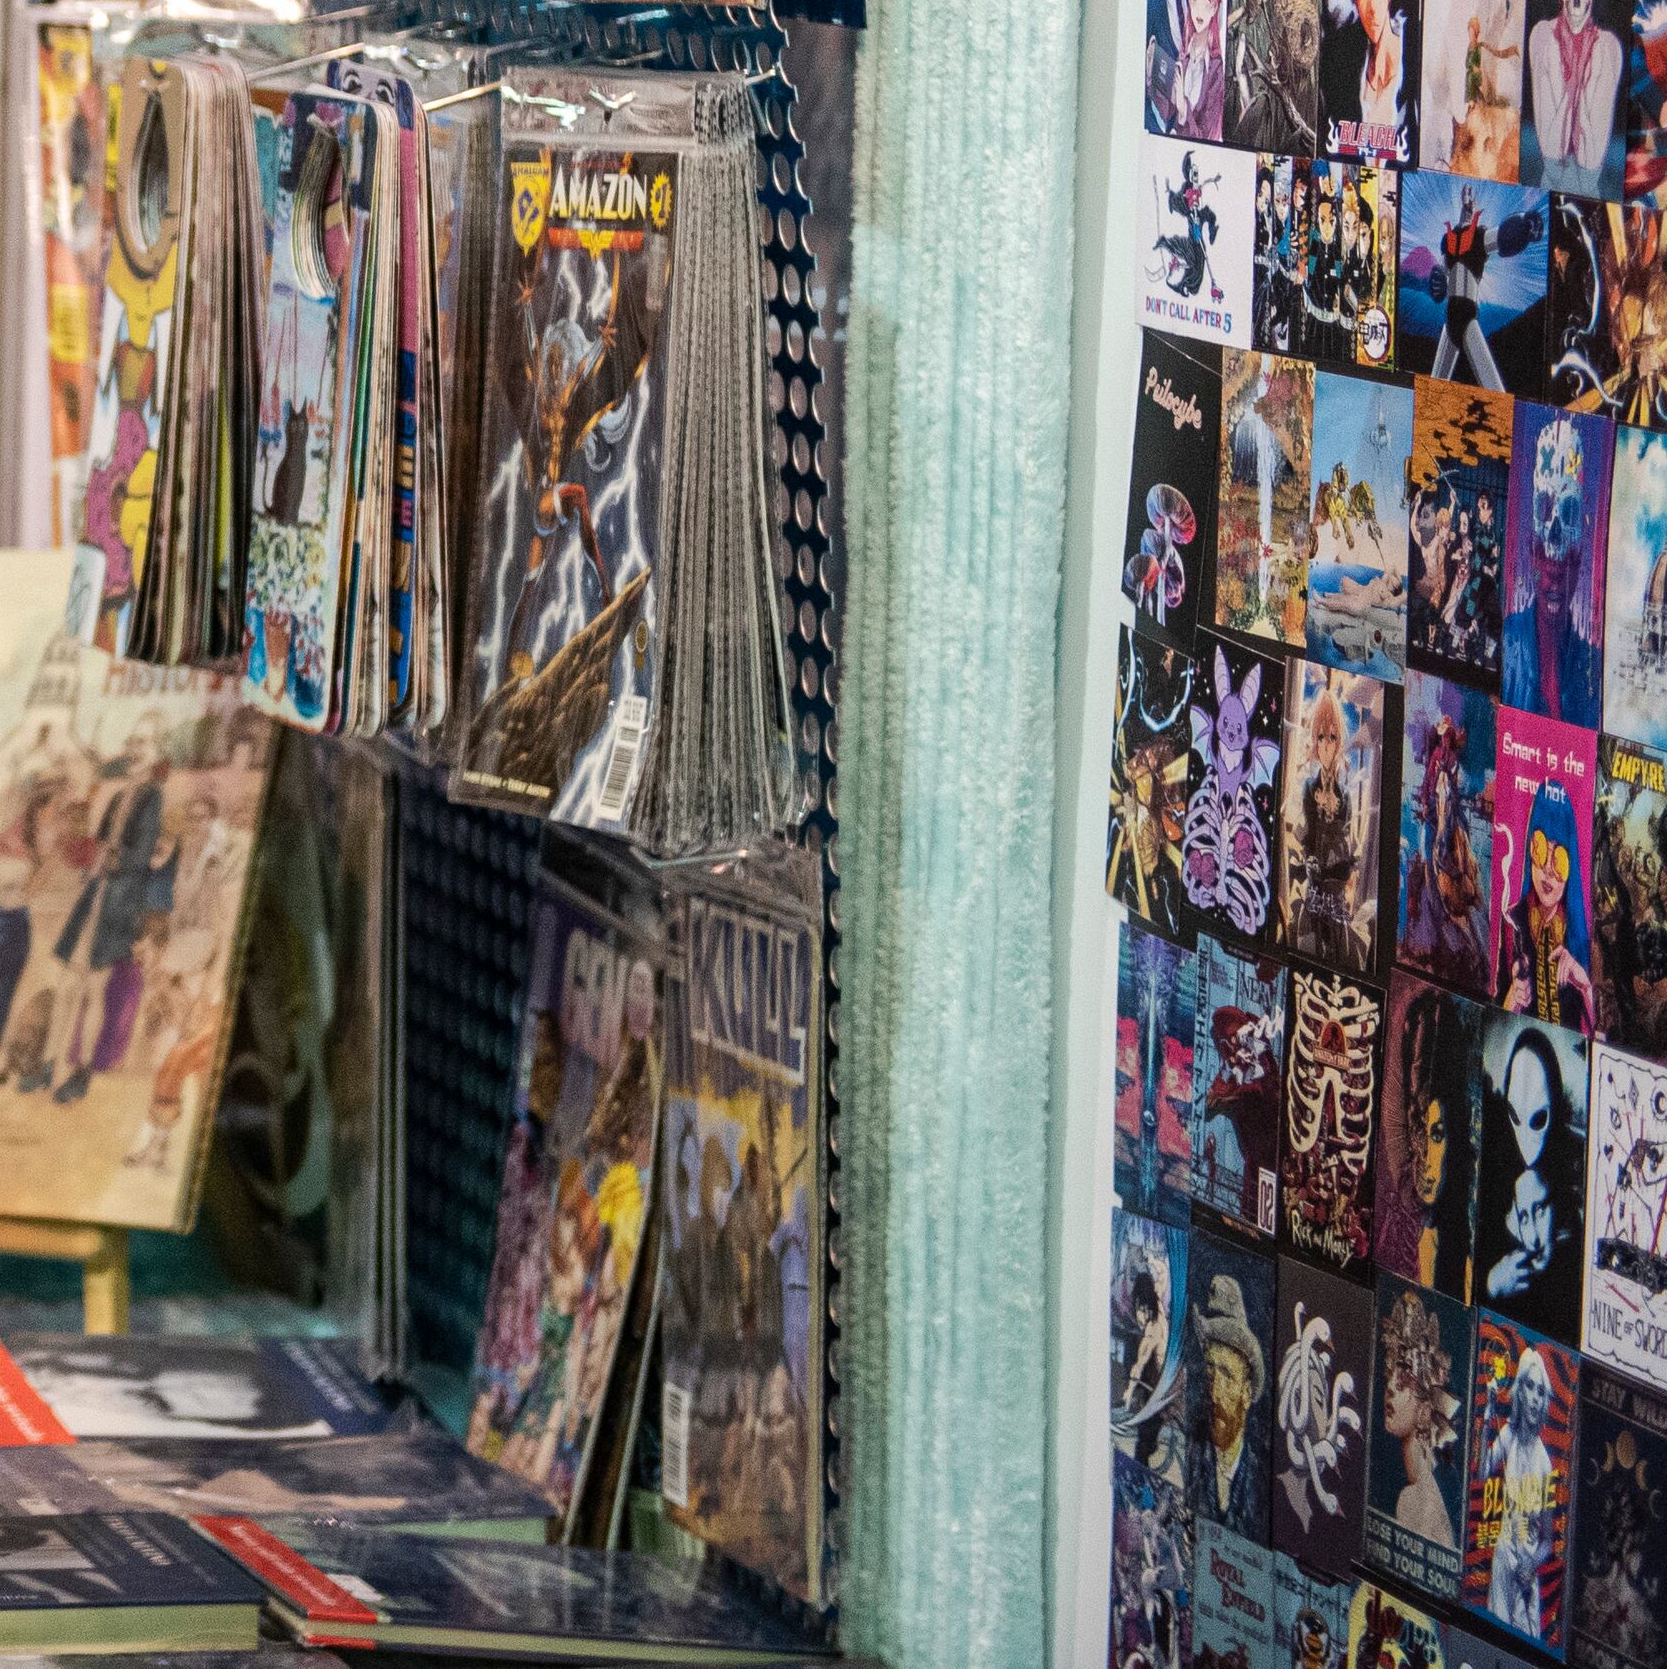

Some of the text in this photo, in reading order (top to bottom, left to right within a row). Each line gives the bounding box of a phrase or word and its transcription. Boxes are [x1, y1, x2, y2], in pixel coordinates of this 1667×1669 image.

[1338, 120, 1398, 151] BLEACH
[547, 163, 648, 221] AMAZON
[1169, 303, 1191, 322] CALL
[1192, 308, 1222, 329] AFTER
[1223, 313, 1232, 333] 5
[1503, 732, 1585, 778] Smart is the
[1611, 749, 1667, 794] EMPYRE
[1515, 775, 1566, 805] new hot
[1592, 1298, 1623, 1341] NINE
[1394, 1553, 1425, 1578] YOUR
[1395, 1528, 1425, 1558] YOUR
[1426, 1545, 1459, 1573] MIND
